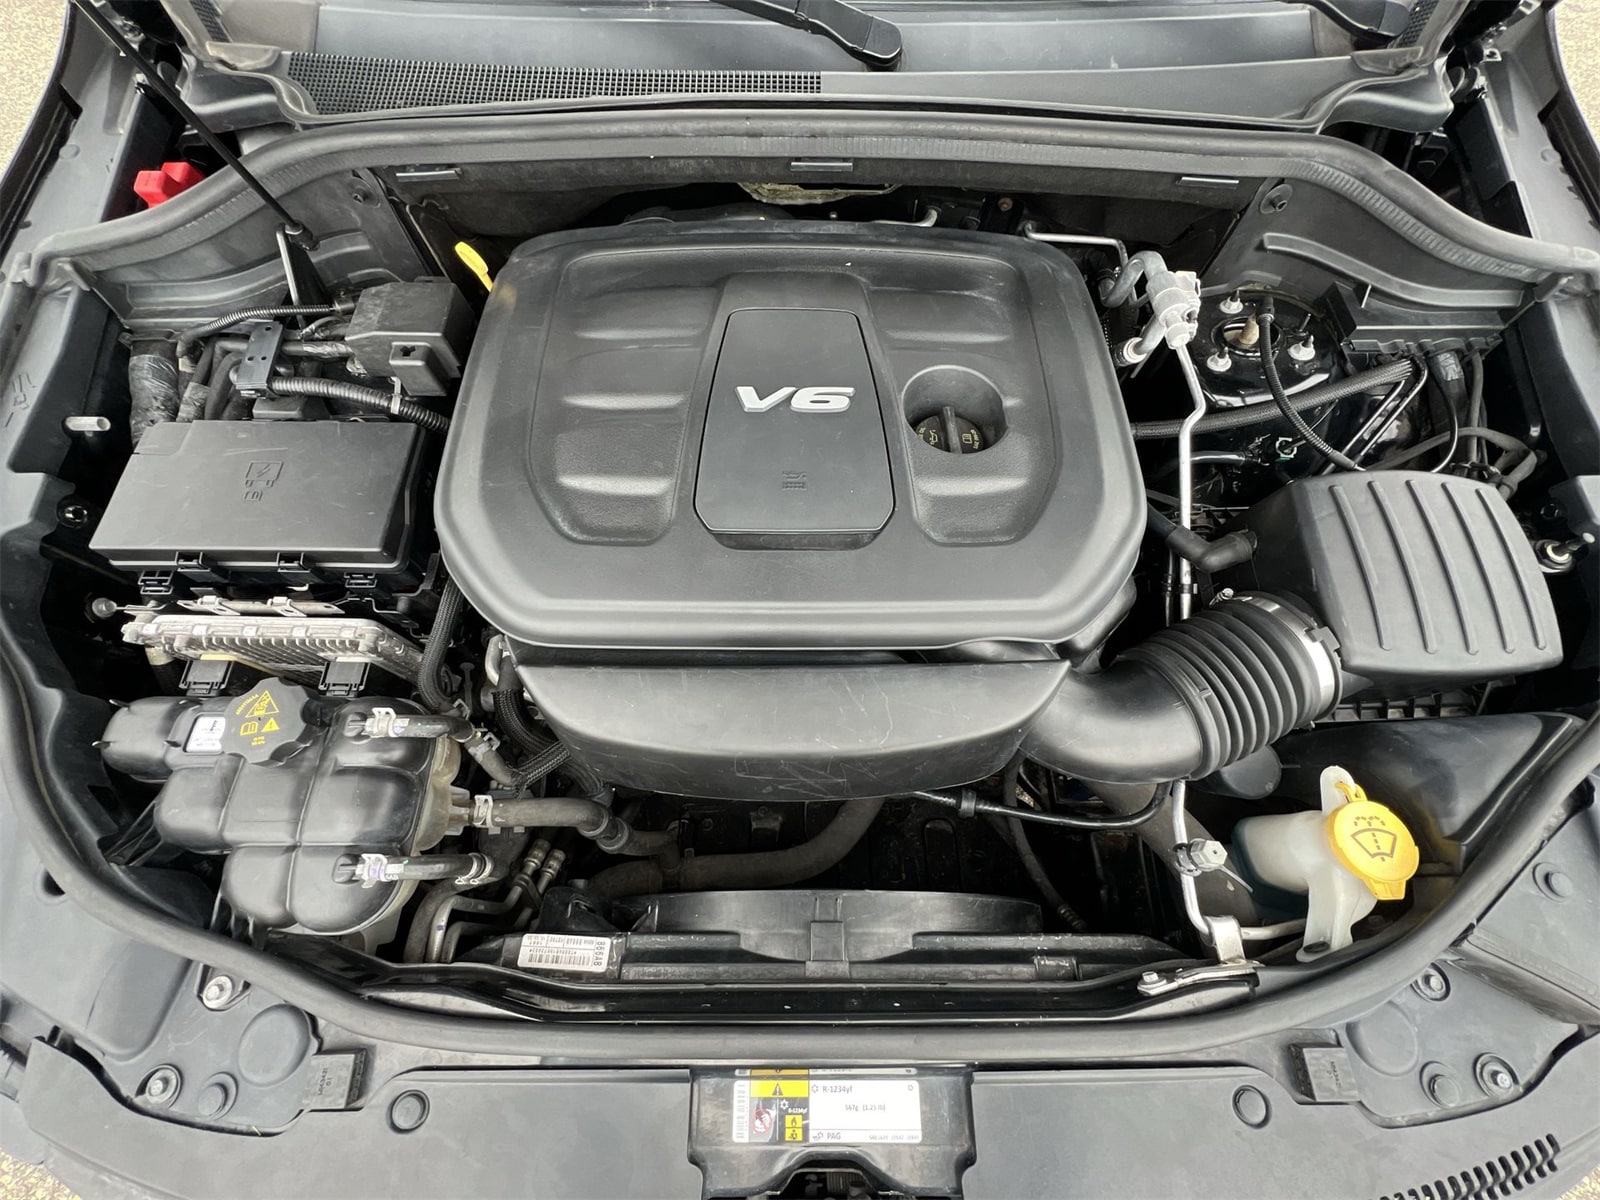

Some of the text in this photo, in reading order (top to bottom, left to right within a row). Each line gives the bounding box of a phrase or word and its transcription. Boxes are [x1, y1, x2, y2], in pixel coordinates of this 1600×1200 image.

[736, 385, 856, 413] V6
[822, 1085, 853, 1094] R-1234yf
[826, 1132, 841, 1140] PAG
